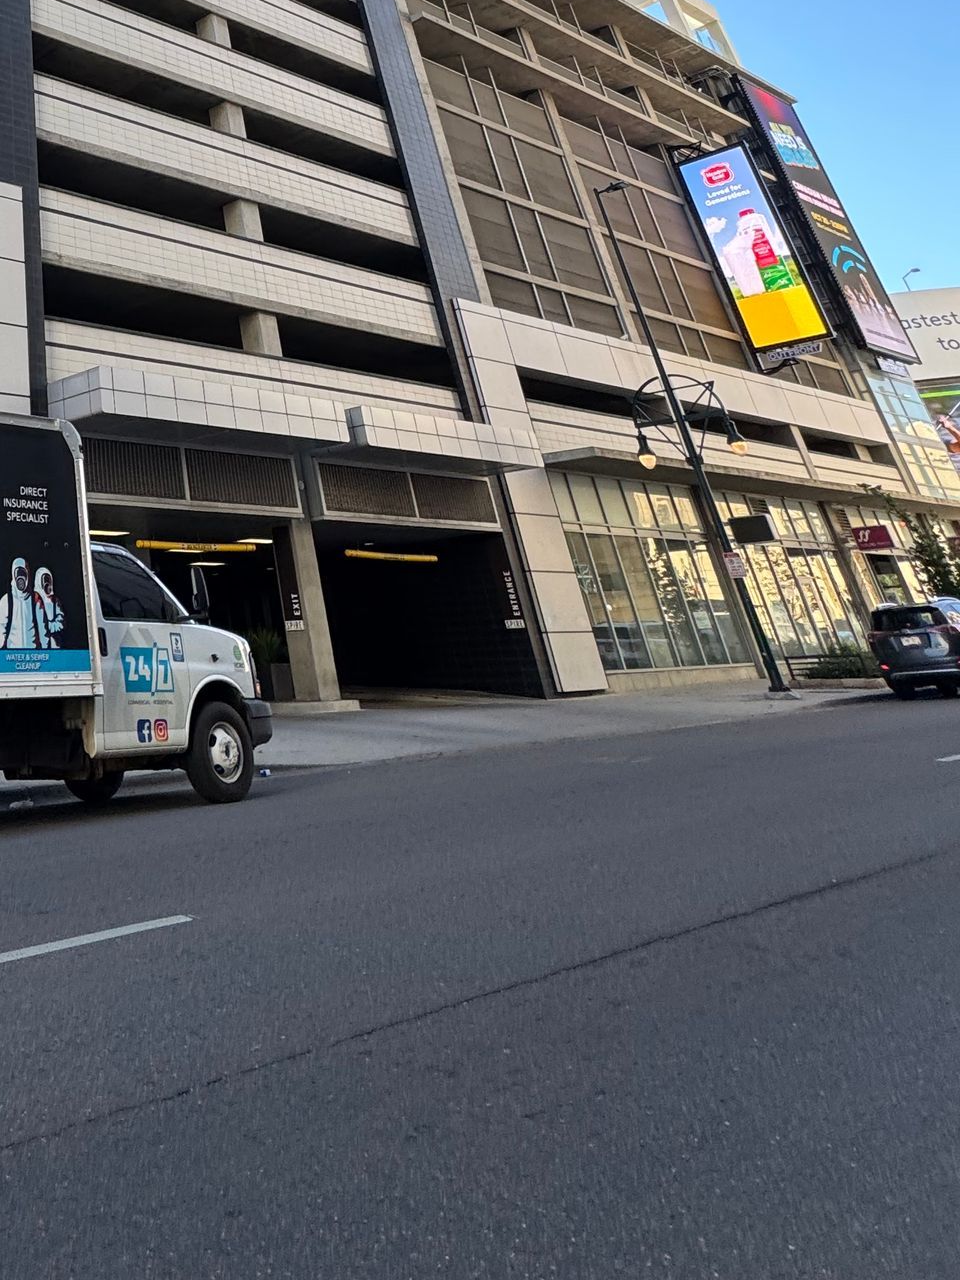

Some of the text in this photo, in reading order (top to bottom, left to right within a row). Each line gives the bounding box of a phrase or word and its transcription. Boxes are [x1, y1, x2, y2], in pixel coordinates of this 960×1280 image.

[705, 189, 750, 206] Generations
[707, 184, 742, 198] Loved for
[937, 337, 960, 350] to
[20, 486, 47, 497] DIRECT
[4, 498, 48, 510] INSURANCE
[7, 511, 49, 524] SPECIALIST
[503, 571, 520, 616] ENTRANCE
[291, 593, 301, 616] EXIT
